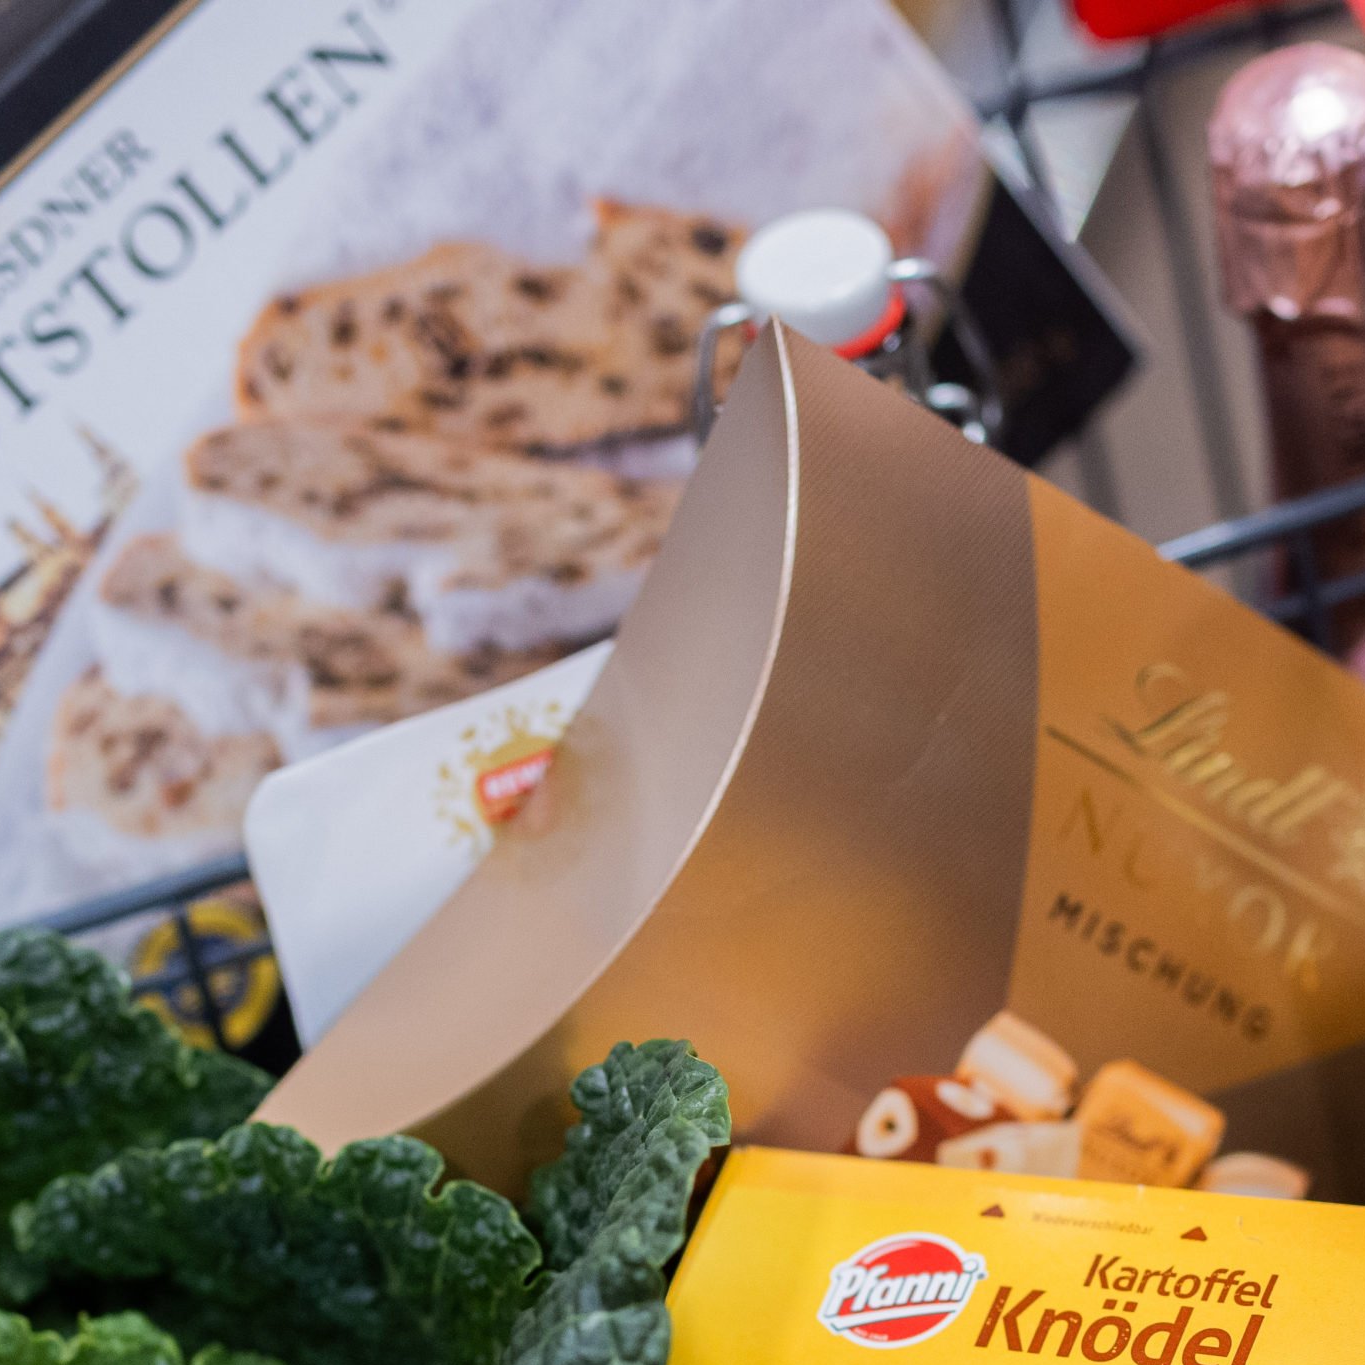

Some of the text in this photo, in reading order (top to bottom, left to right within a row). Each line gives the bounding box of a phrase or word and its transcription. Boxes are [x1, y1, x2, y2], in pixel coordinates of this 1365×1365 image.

[1049, 892, 1274, 1042] MISCHUNG
[823, 1259, 980, 1318] Pfanni
[1083, 1254, 1279, 1309] Kartoffel
